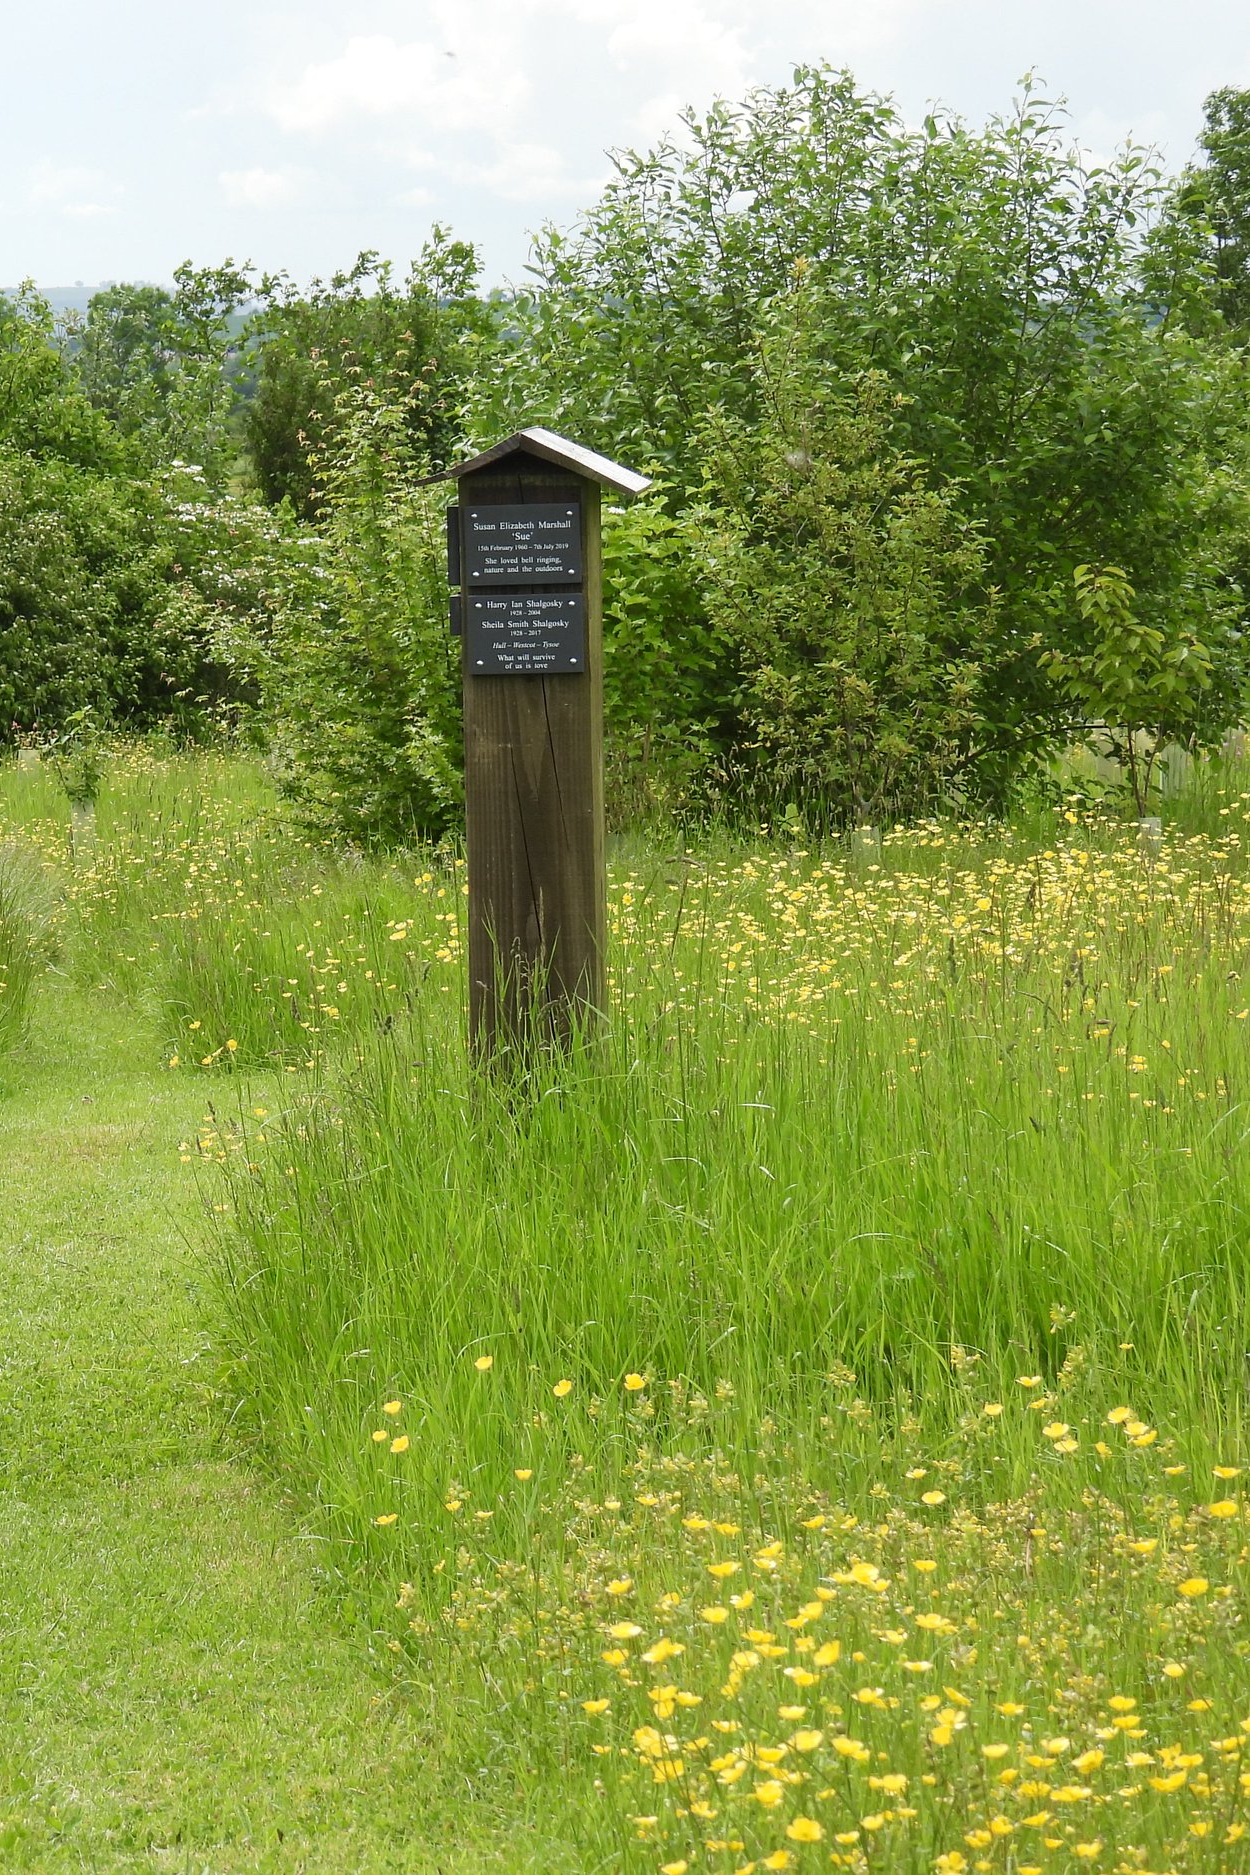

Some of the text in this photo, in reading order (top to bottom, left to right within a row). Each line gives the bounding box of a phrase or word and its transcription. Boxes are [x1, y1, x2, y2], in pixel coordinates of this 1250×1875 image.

[500, 522, 534, 530] Elizabeth
[539, 520, 571, 528] Marshall
[487, 601, 507, 610] Harry
[526, 600, 563, 609] Shalgosky
[508, 620, 529, 628] Smith
[533, 619, 569, 628] Shalgosky
[543, 641, 559, 649] Tysoe
